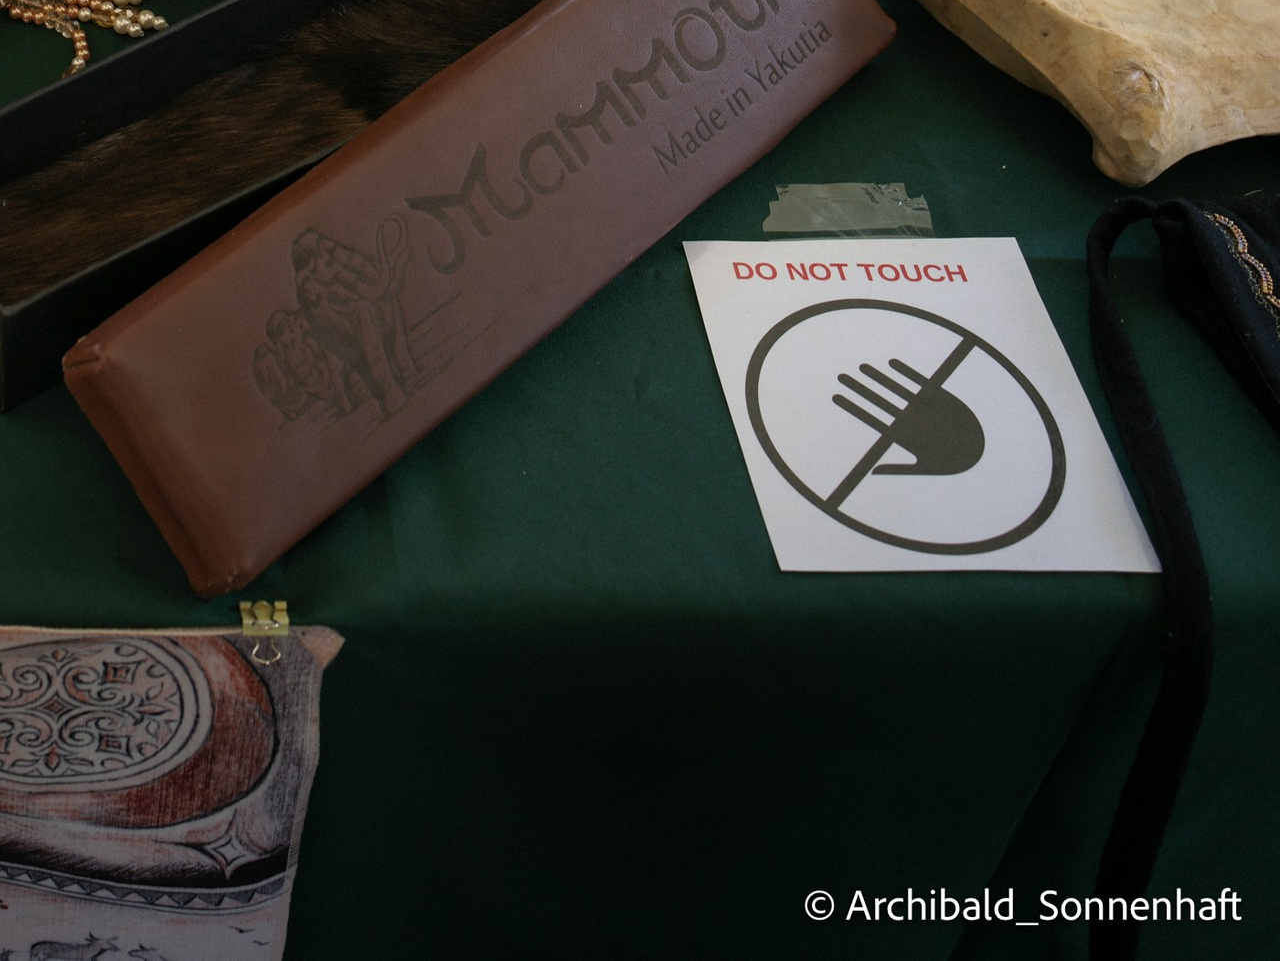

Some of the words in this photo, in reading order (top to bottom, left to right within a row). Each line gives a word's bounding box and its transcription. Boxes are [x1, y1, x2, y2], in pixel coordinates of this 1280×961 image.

[652, 101, 727, 177] Made
[722, 84, 754, 118] in
[744, 19, 833, 95] Yakutia
[732, 261, 778, 281] DO
[786, 262, 848, 281] NOT
[856, 263, 968, 283] TOUCH
